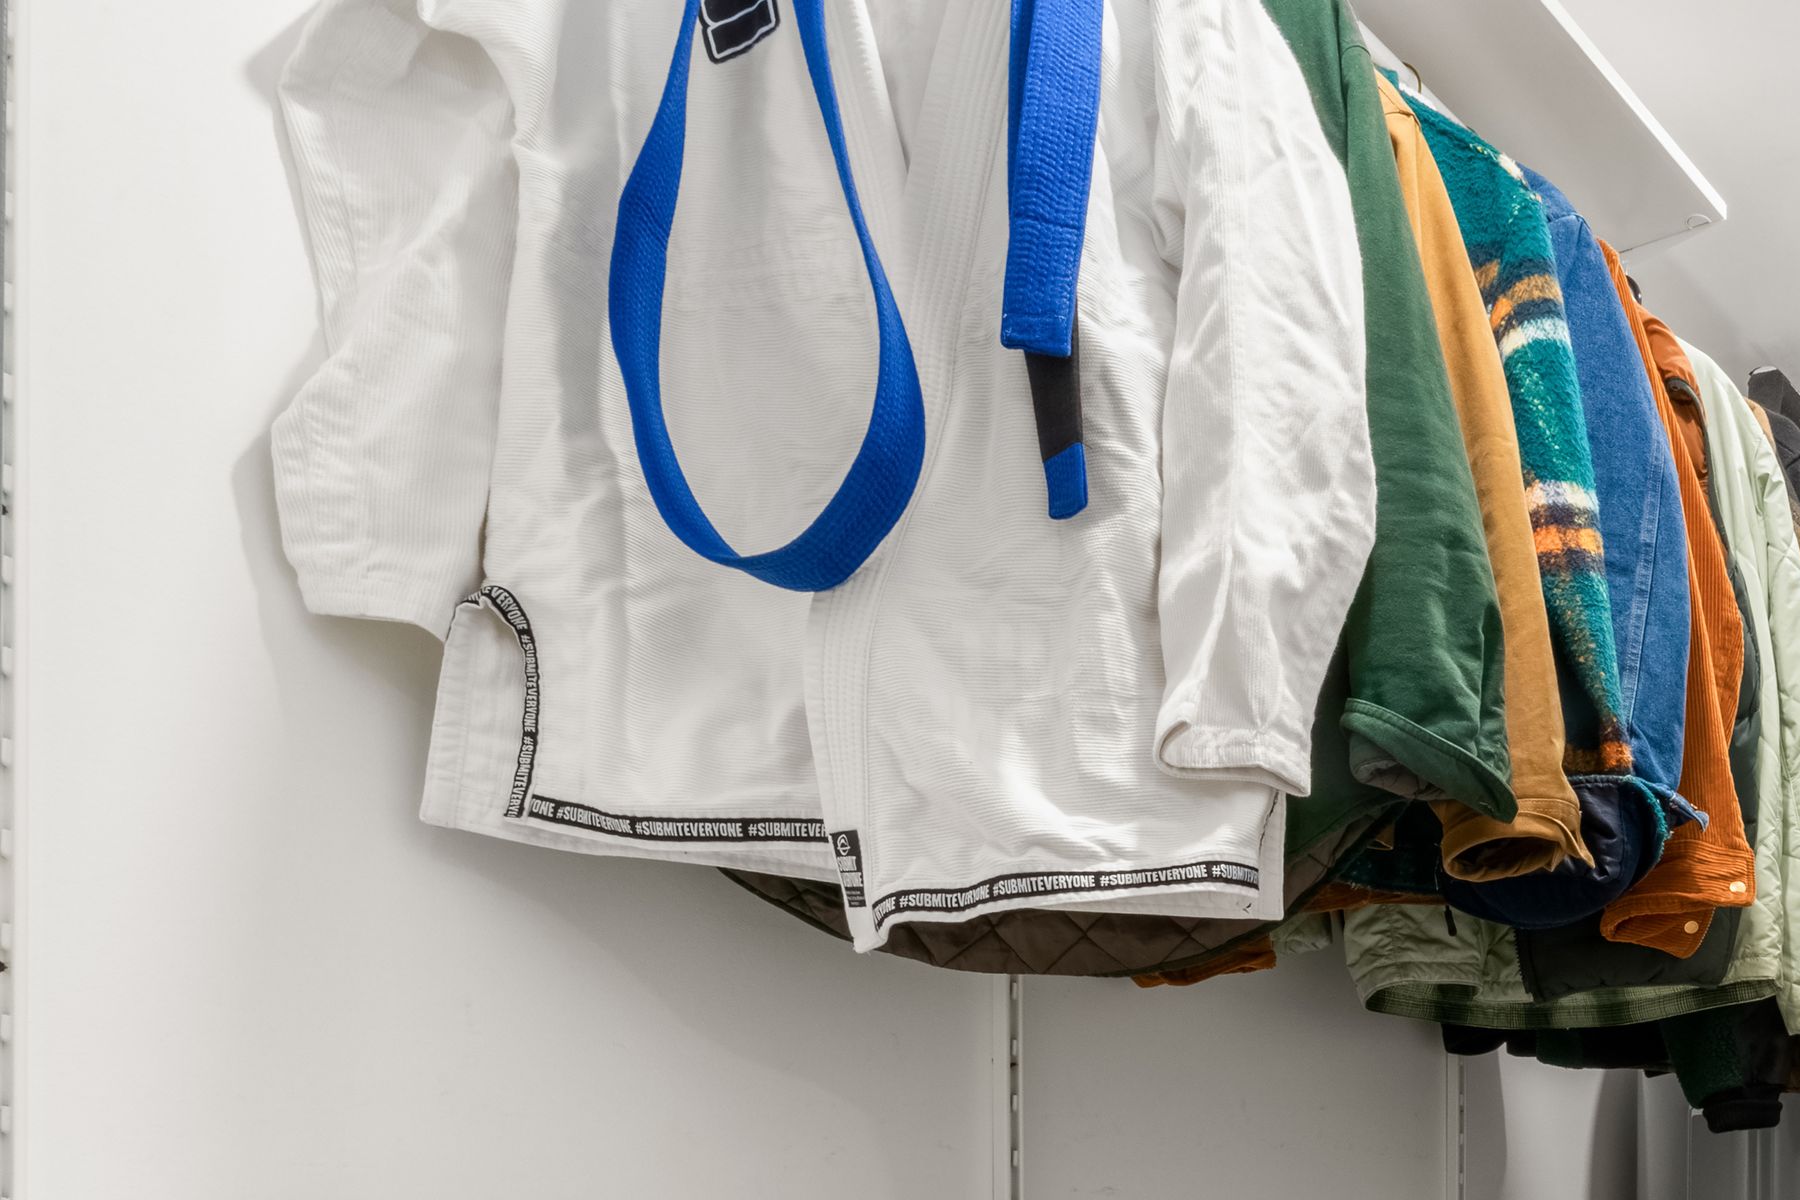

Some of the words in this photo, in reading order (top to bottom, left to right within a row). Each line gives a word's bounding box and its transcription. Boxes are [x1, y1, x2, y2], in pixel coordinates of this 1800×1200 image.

[635, 820, 744, 838] #SUBMITEVERYONE
[899, 884, 991, 909] #SUBMITEVERYONE
[993, 873, 1096, 897] #SUBMITEVERYONE
[1100, 864, 1208, 887] #SUBMITEVERYONE
